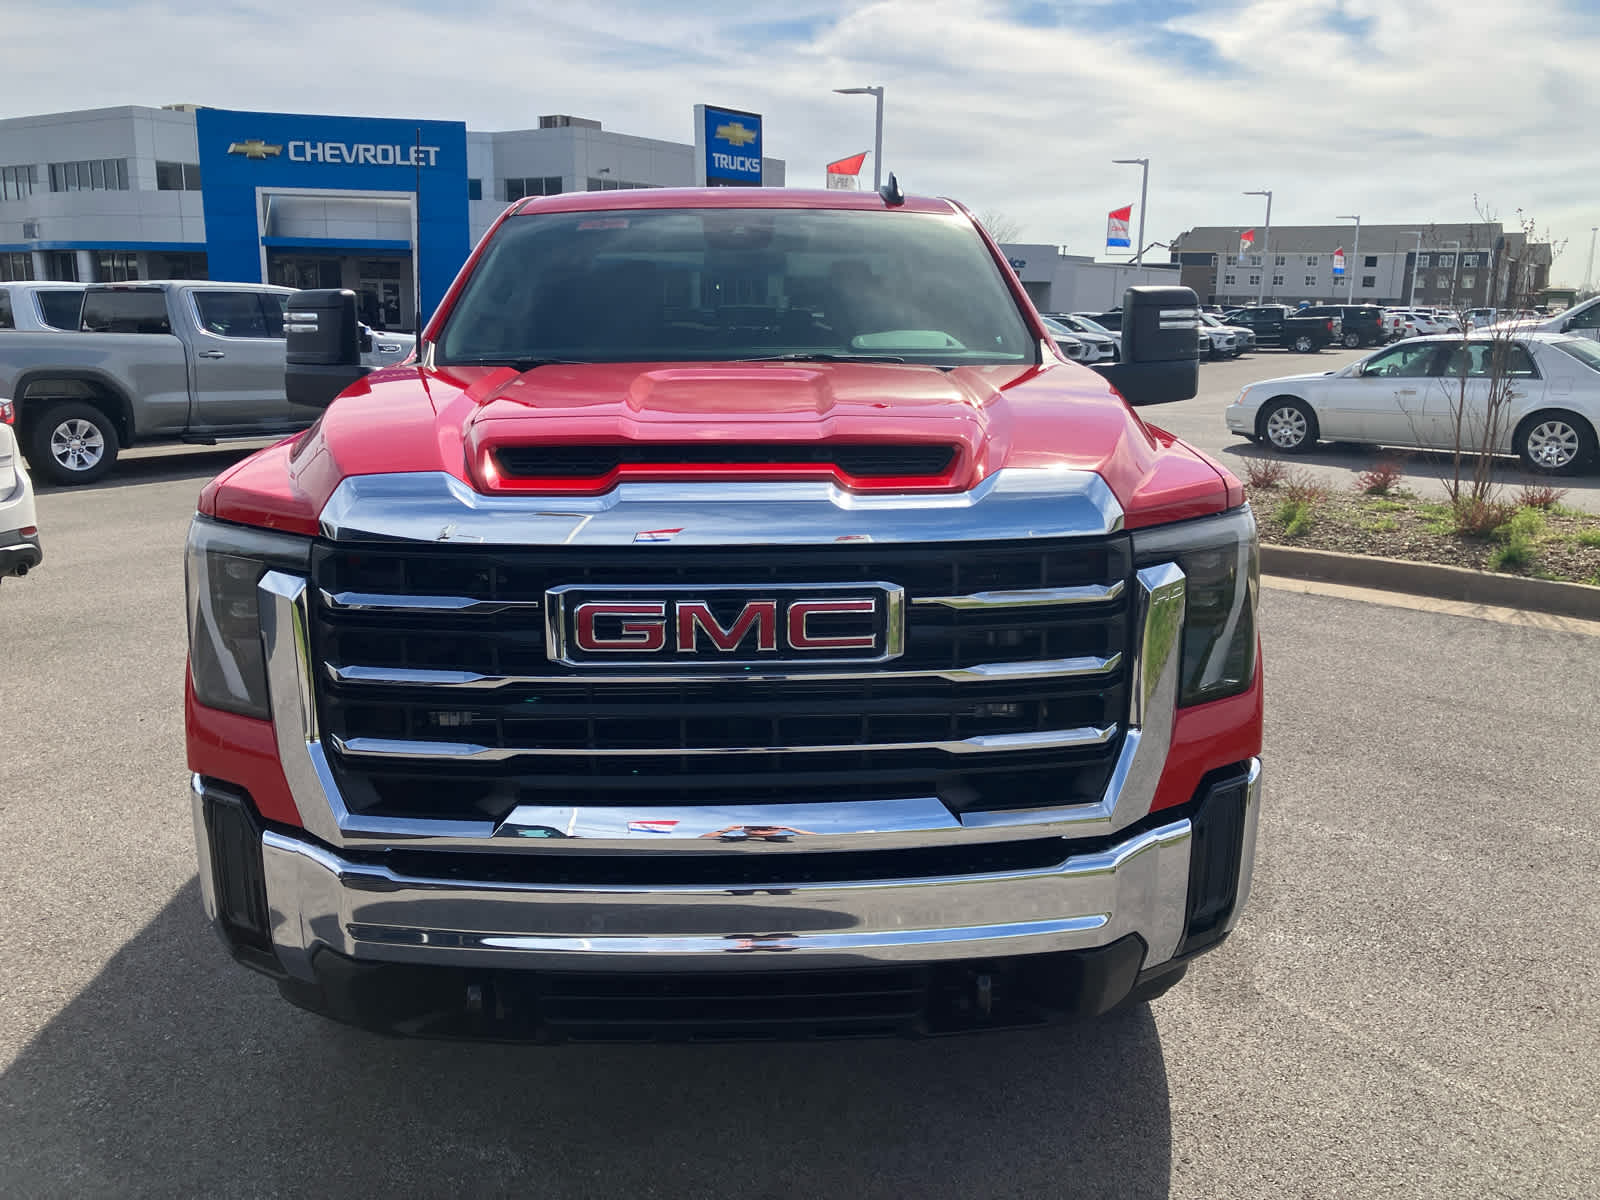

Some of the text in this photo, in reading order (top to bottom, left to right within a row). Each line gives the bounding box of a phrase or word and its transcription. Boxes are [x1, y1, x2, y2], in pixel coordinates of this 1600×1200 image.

[287, 140, 440, 167] CHEVROLET
[712, 152, 760, 173] TRUCKS
[574, 599, 876, 653] GMC
